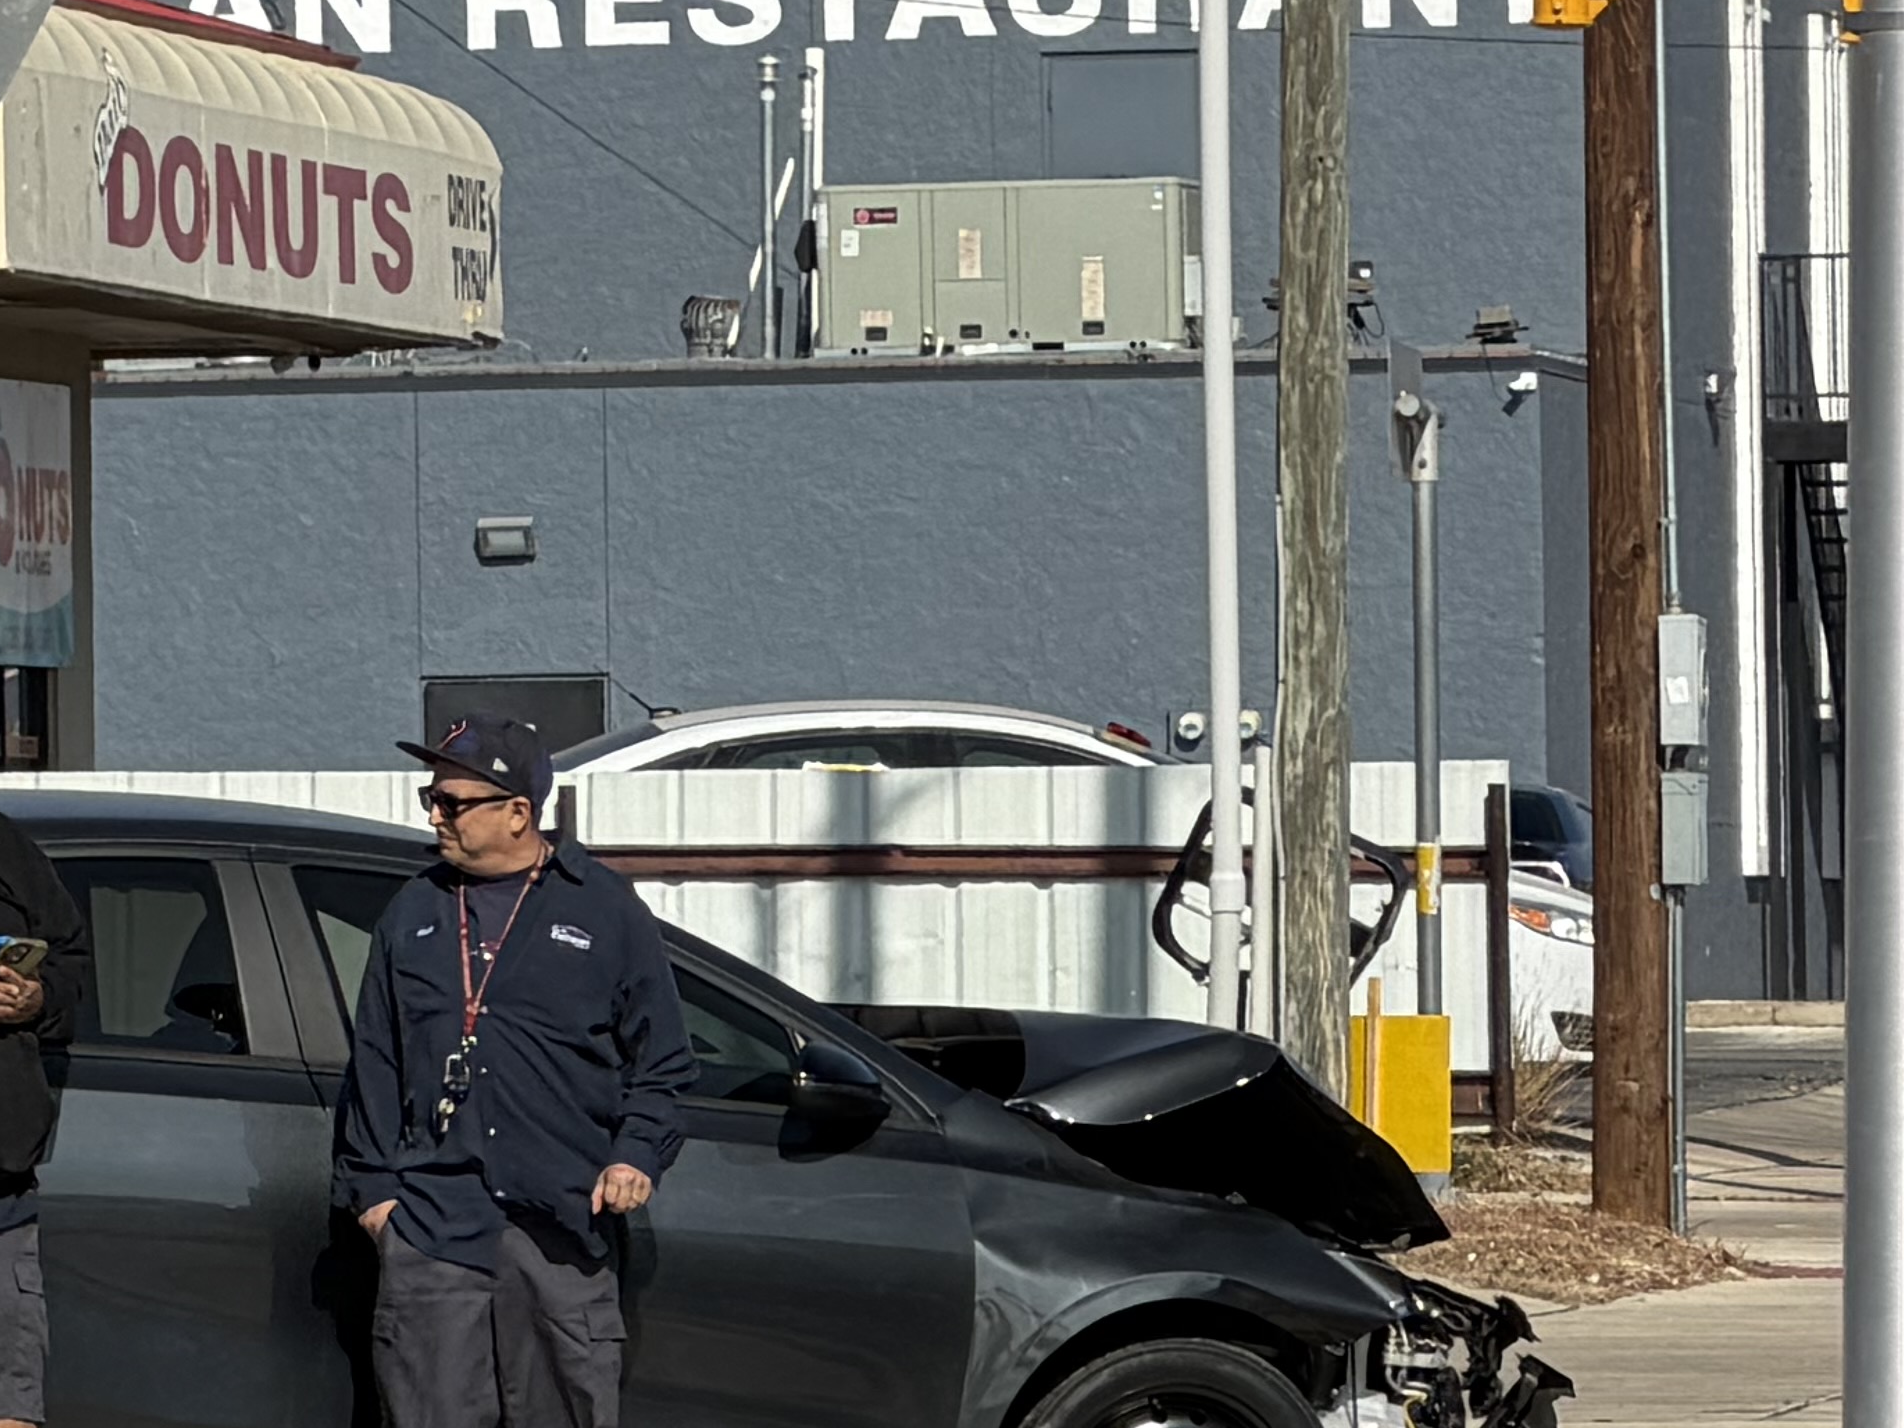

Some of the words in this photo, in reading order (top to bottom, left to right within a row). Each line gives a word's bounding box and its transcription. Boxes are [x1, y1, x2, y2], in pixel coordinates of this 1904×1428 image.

[107, 124, 414, 294] DONUTS
[447, 174, 487, 232] DRIVE
[452, 246, 488, 303] THRU
